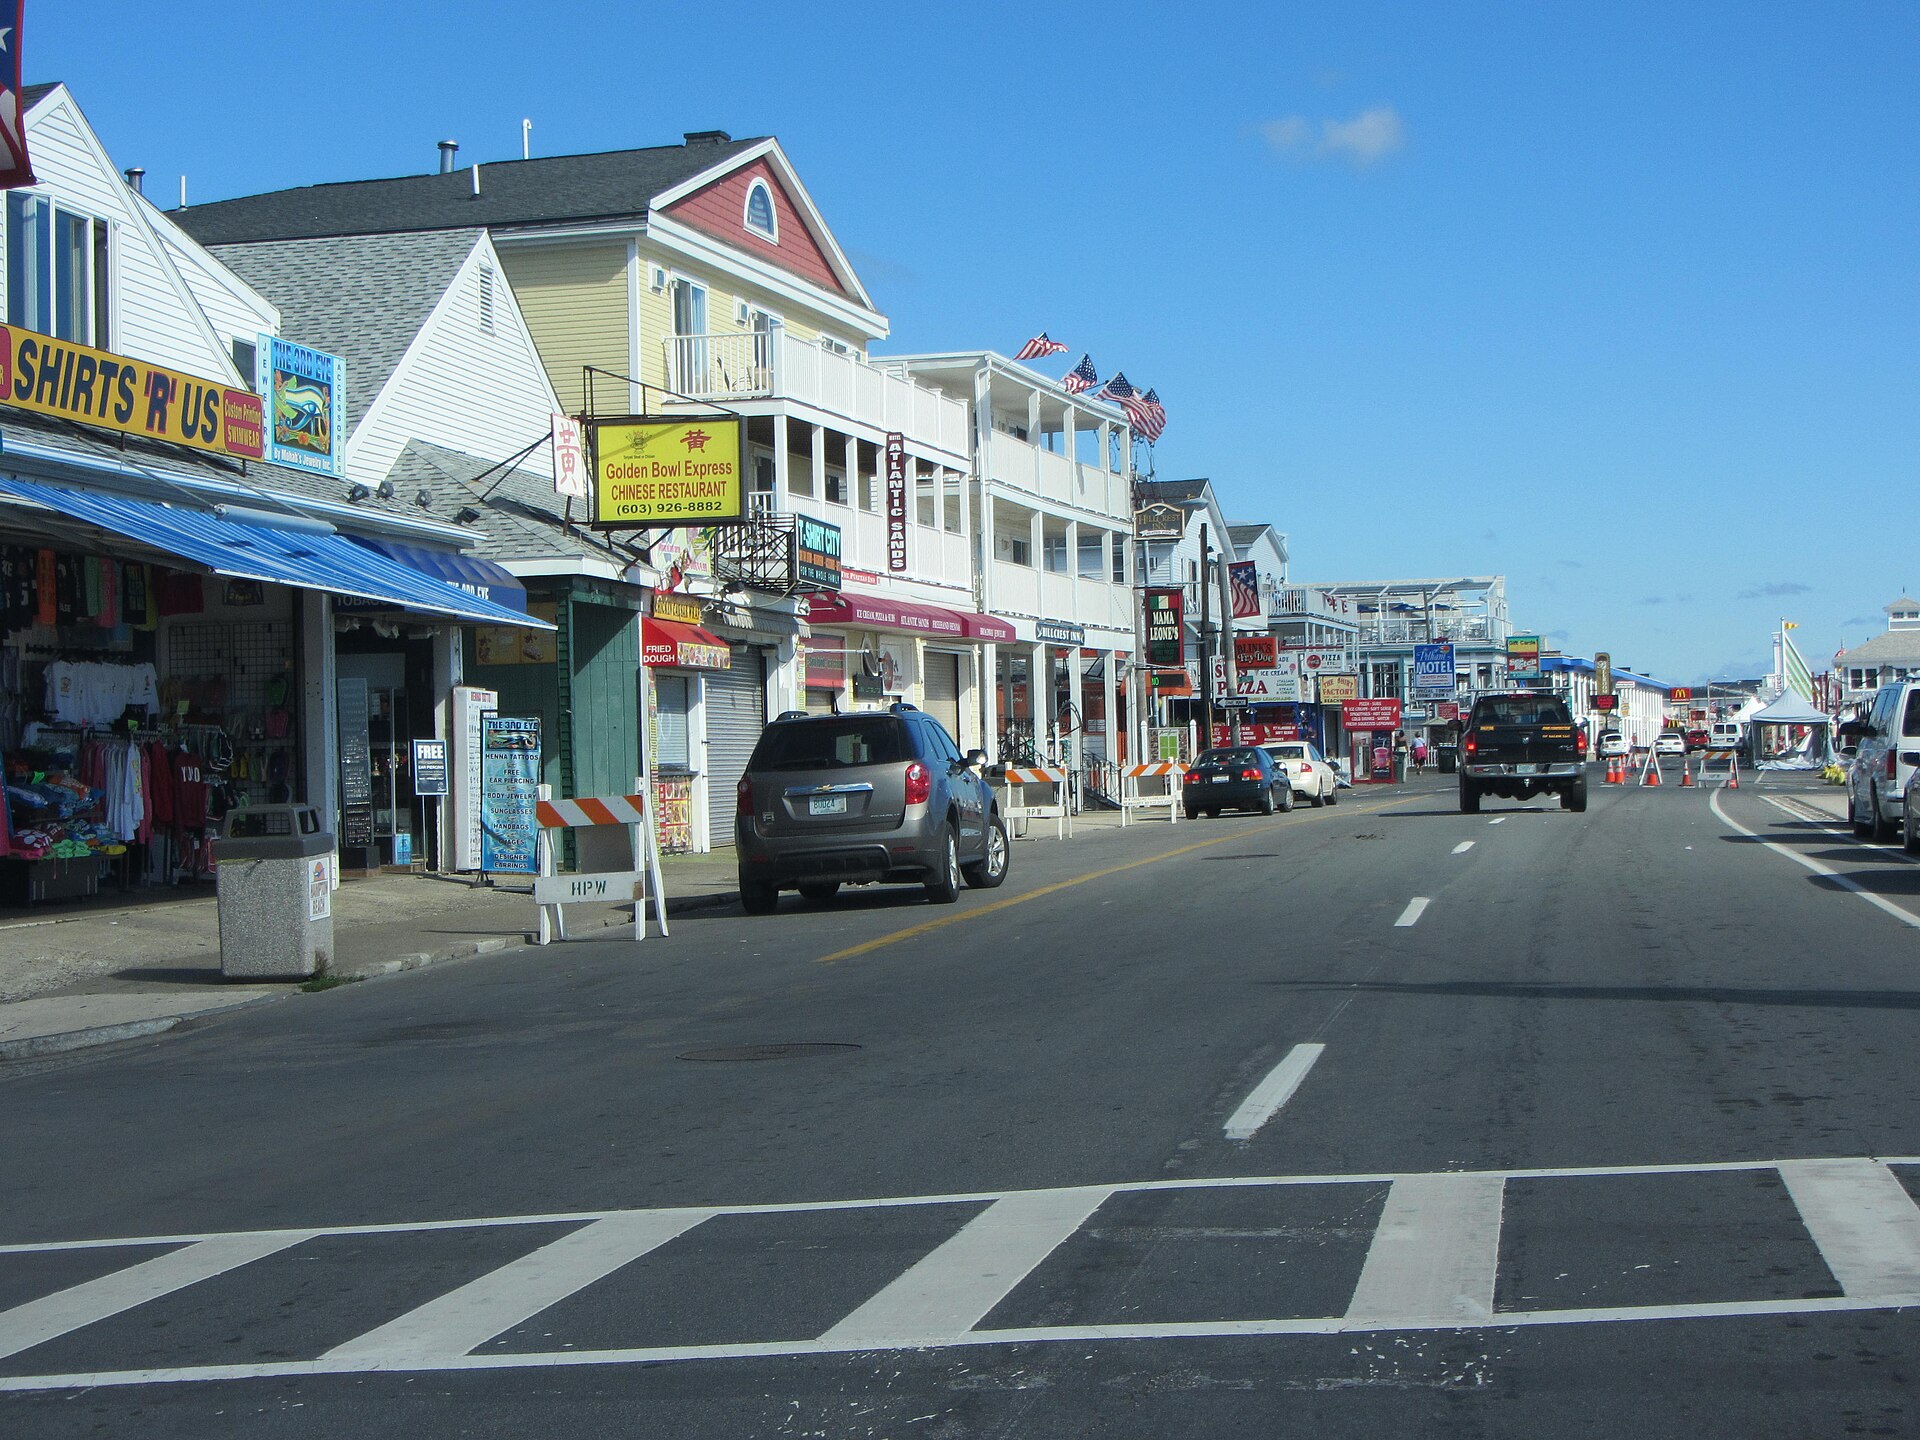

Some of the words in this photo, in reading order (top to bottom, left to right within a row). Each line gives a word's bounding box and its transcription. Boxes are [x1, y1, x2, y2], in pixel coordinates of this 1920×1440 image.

[273, 341, 291, 370] THE
[294, 346, 312, 377] 3RD
[315, 354, 331, 383] EYE
[14, 338, 137, 425] SHIRTS
[180, 383, 219, 444] US
[224, 398, 243, 420] Custom
[242, 403, 261, 430] Printing
[227, 424, 260, 449] SWIMWEAR
[606, 461, 648, 480] Golden
[652, 460, 681, 478] Bowl
[684, 459, 732, 480] Express
[888, 442, 904, 516] ATLANTIC
[611, 483, 656, 501] CHINESE
[658, 481, 727, 500] RESTAURANT
[616, 503, 652, 516] (603)
[656, 501, 722, 513] 926-8882
[1138, 514, 1181, 525] HILLCREST
[799, 519, 825, 552] T-SHIRT
[825, 527, 840, 557] CITY
[891, 522, 905, 569] SANDS
[807, 567, 815, 578] THE
[900, 615, 918, 627] ATLANTIC
[917, 617, 930, 628] SANDS
[1152, 611, 1175, 625] MAMA
[1149, 626, 1179, 641] LEONE'S
[646, 645, 672, 654] FRIED
[643, 654, 675, 663] DOUGH
[1237, 653, 1253, 664] Fry
[1254, 650, 1273, 662] Doe
[1416, 661, 1453, 674] MOTEL
[1216, 680, 1268, 695] PZZA
[1322, 679, 1334, 688] THE
[1322, 688, 1355, 696] FACTORY
[487, 721, 503, 729] THE
[505, 721, 522, 729] 3RD
[523, 721, 538, 730] EYE
[417, 745, 443, 759] FREE
[1026, 807, 1043, 816] HPW
[493, 823, 530, 831] HANDBAGS
[494, 853, 528, 861] DESIGNER
[494, 861, 528, 869] EARRINGS
[571, 880, 607, 896] HPW
